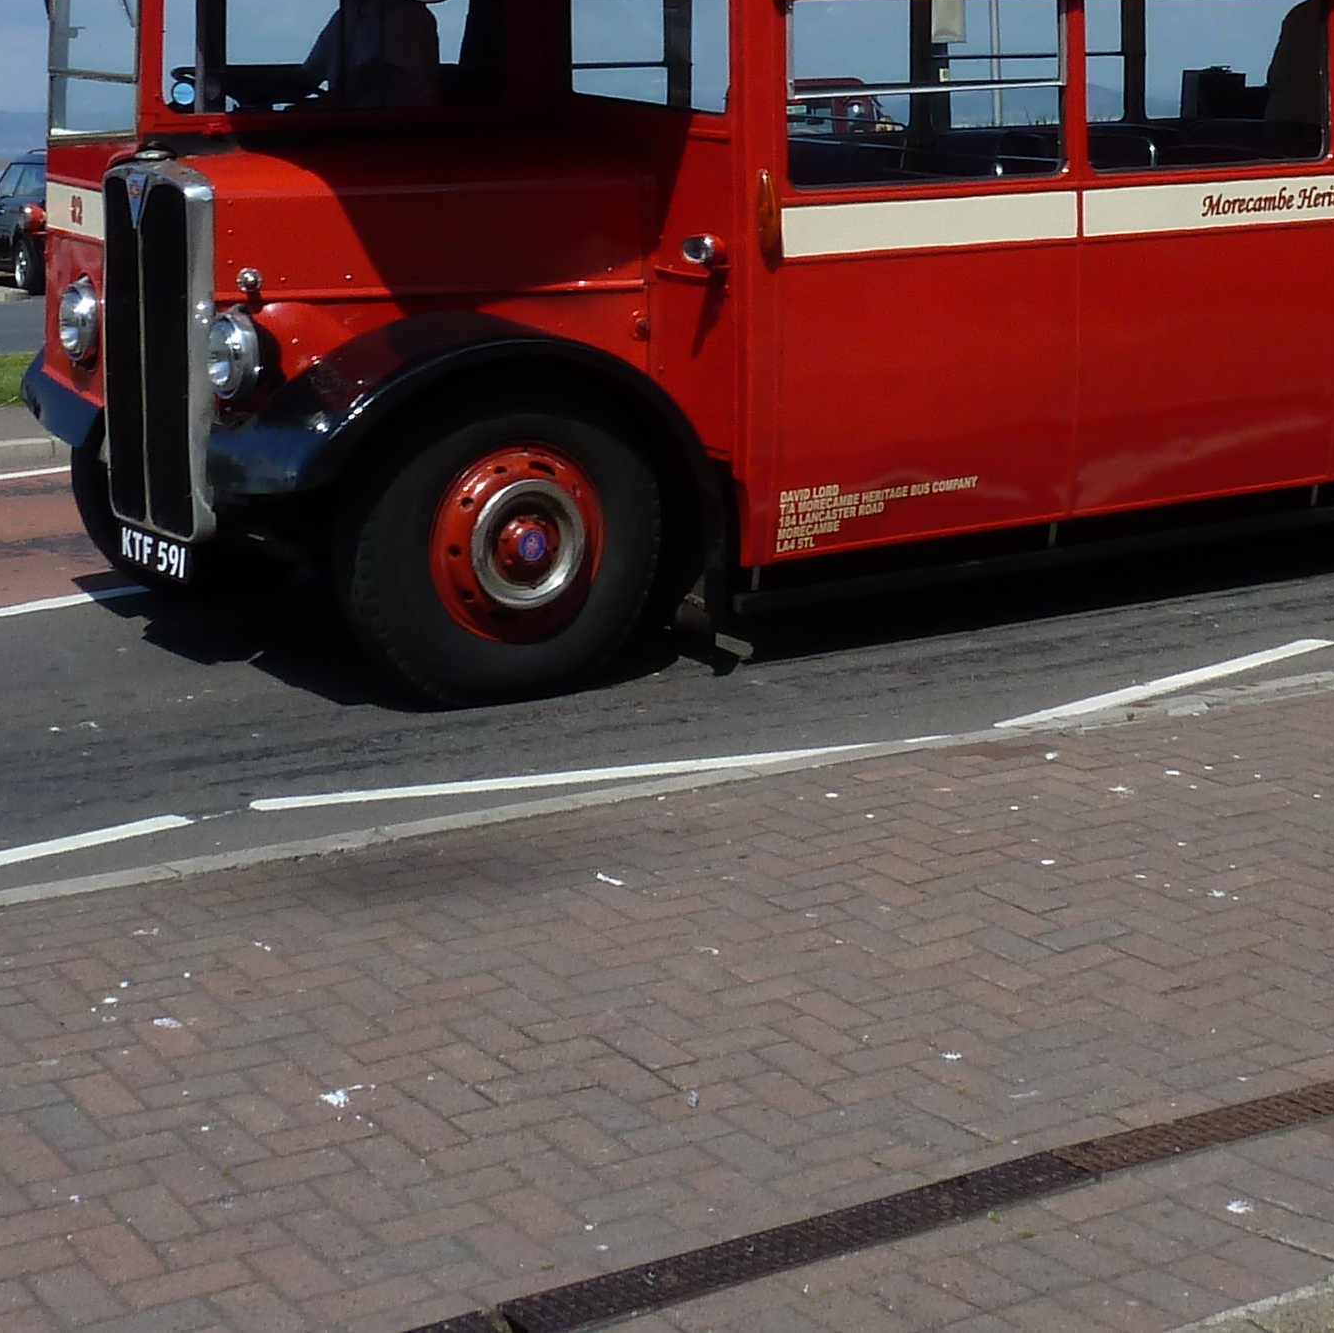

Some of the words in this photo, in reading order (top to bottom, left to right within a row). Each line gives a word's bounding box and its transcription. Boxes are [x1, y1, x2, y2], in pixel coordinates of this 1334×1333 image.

[1200, 186, 1294, 217] Morecambe
[780, 487, 811, 503] DAVID
[813, 484, 840, 499] LORD
[799, 493, 860, 513] MORECAMBE
[862, 485, 909, 504] HERITAGE
[911, 482, 931, 496] BUS
[933, 475, 978, 493] COMPANY
[799, 506, 857, 525] LANCASTER
[858, 502, 884, 517] ROAD
[778, 520, 841, 541] MORECAMBE
[122, 526, 154, 565] KTF
[156, 541, 186, 578] 591
